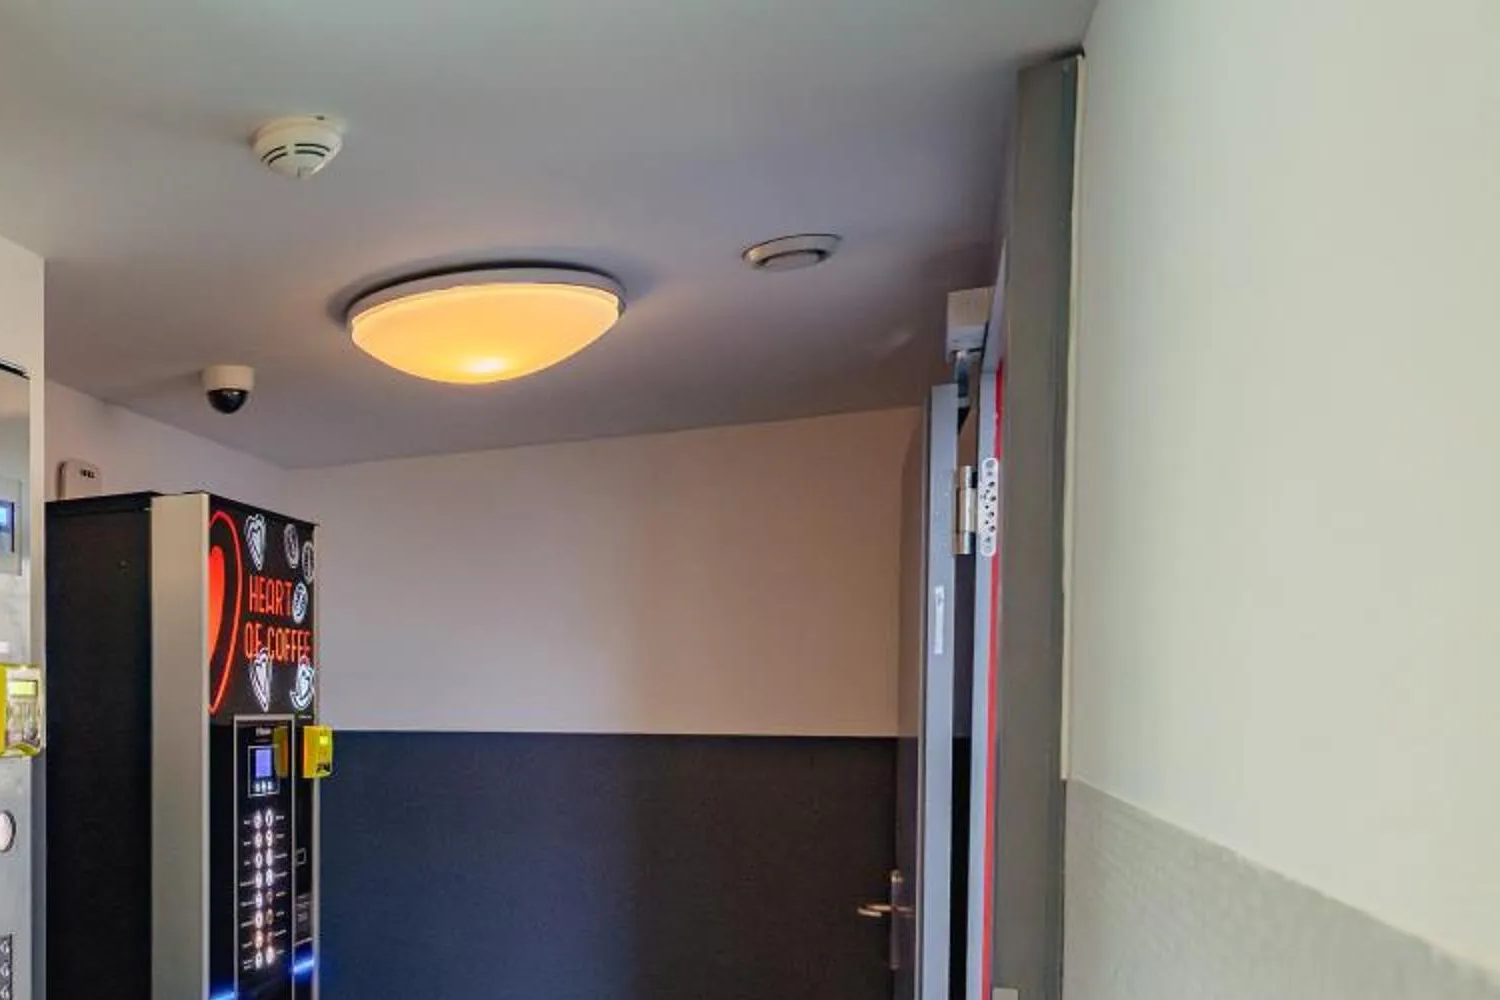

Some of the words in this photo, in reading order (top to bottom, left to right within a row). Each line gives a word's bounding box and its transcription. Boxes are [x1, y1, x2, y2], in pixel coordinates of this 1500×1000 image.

[249, 575, 293, 617] HEART
[243, 621, 263, 660] OF
[267, 627, 311, 665] COFFEE
